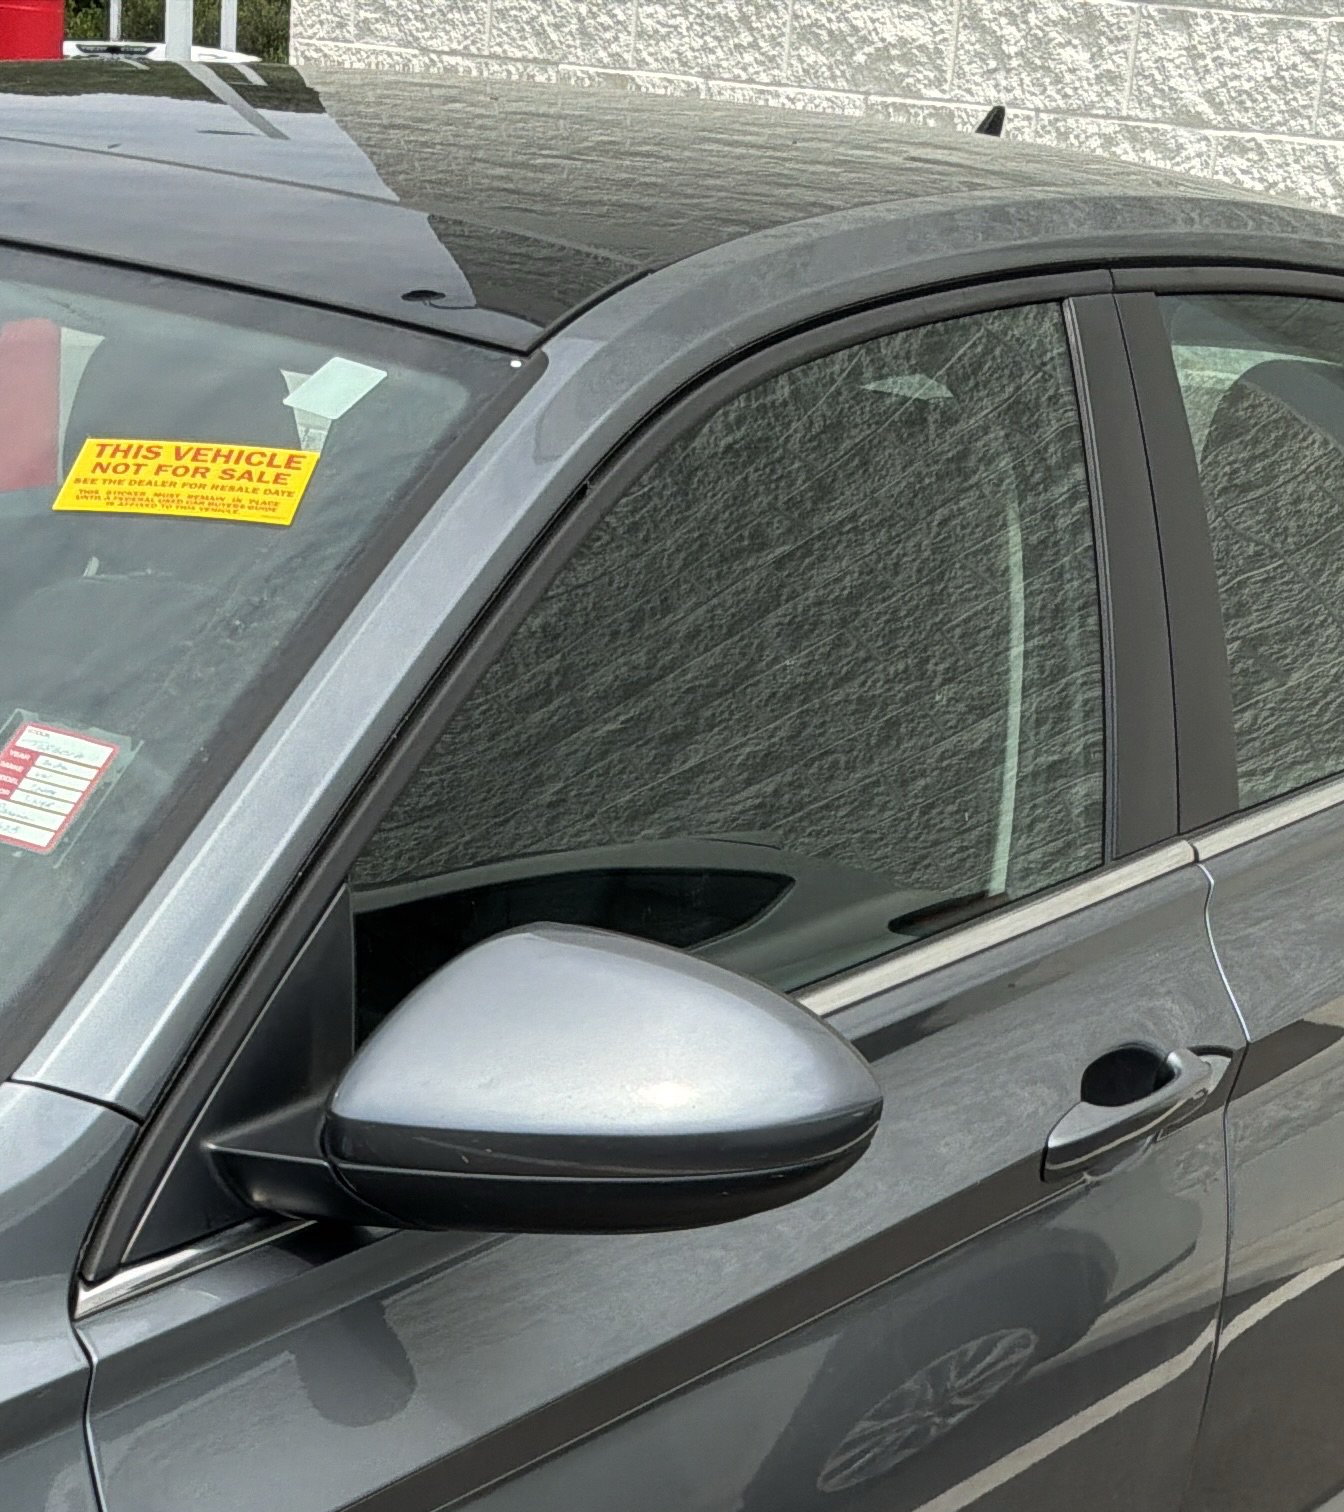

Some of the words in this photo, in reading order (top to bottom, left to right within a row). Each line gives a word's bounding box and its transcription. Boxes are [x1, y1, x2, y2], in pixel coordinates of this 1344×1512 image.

[96, 444, 163, 460] THIS
[175, 446, 307, 470] VEHICLE
[91, 462, 148, 475] NOT
[154, 464, 210, 478] FOR
[218, 468, 291, 485] SALE
[74, 477, 98, 485] SEE
[102, 478, 125, 486] THE
[128, 479, 178, 488] DEALER
[181, 482, 207, 490] FOR
[211, 483, 260, 494] RESALE
[263, 488, 295, 498] DATE
[9, 749, 31, 761] YEAR
